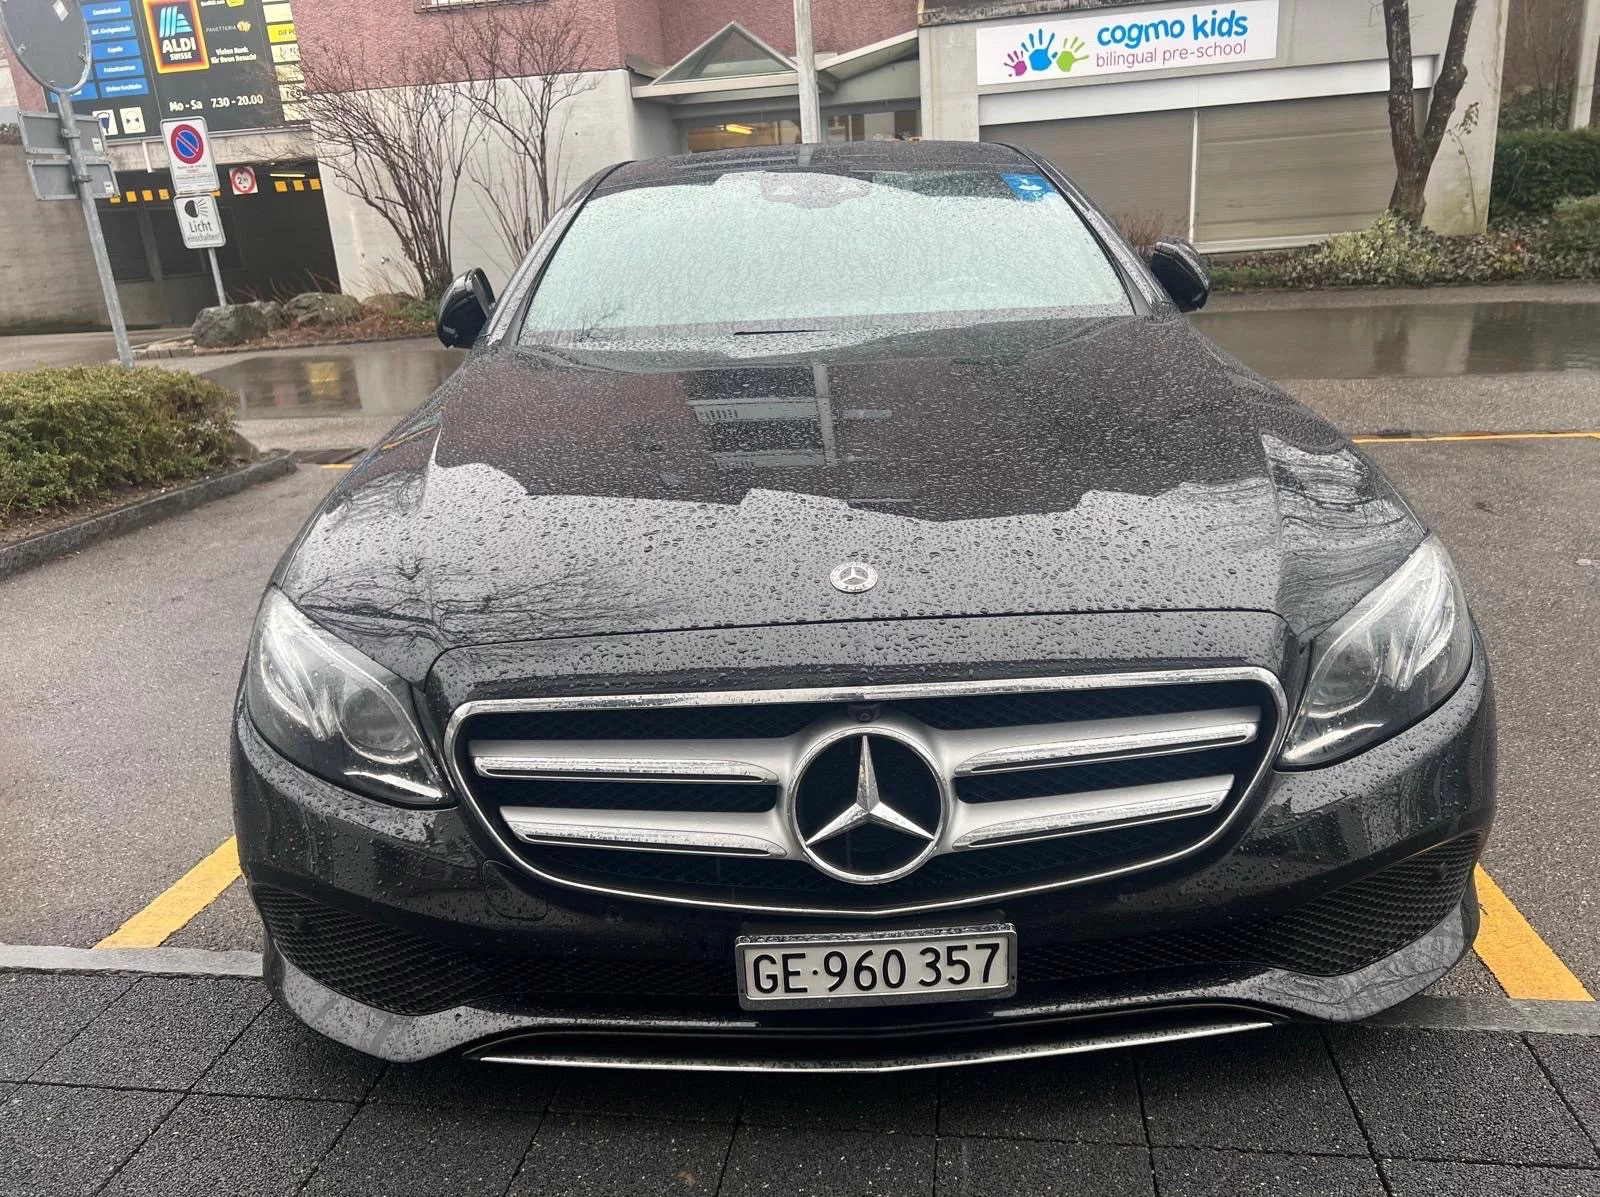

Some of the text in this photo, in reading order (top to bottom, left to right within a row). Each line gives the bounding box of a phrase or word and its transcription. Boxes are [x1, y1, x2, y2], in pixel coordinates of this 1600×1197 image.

[1096, 9, 1248, 49] cogmo kids
[162, 37, 197, 53] ALDI
[233, 46, 249, 54] Dank
[170, 52, 193, 61] SUISSE
[1096, 39, 1247, 69] bilingual pre-school
[169, 101, 184, 111] Mo
[190, 100, 203, 110] Sa
[236, 95, 263, 106] 20.00
[189, 220, 213, 232] Licht
[918, 942, 1000, 987] 357
